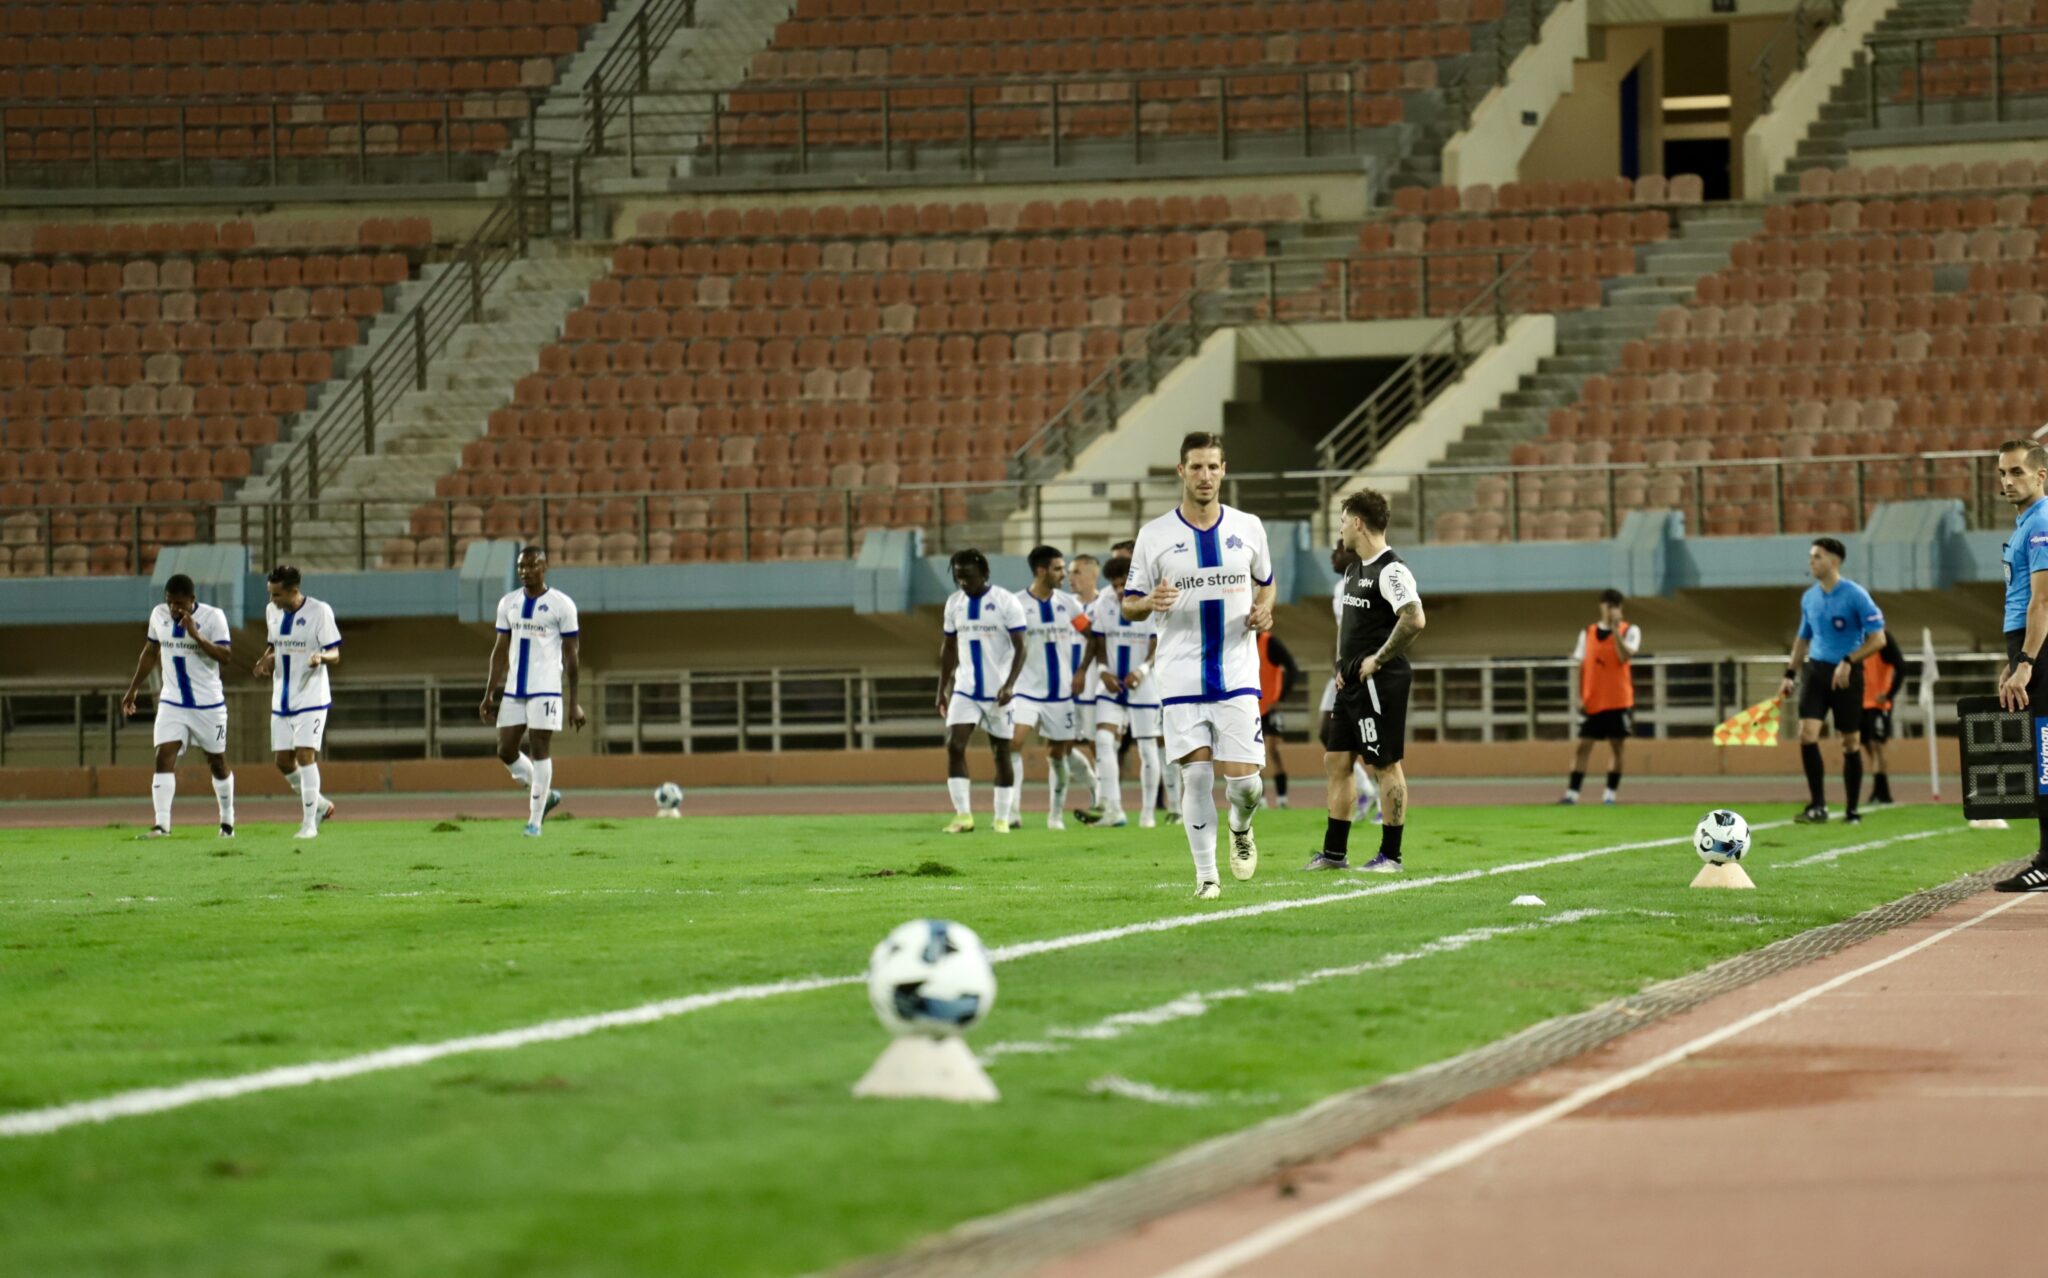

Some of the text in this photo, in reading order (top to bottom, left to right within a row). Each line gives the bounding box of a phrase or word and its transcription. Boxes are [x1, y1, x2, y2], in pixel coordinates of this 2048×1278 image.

[1175, 573, 1246, 591] elite strom
[1343, 593, 1371, 609] etsson
[543, 700, 557, 717] 14
[1358, 717, 1379, 743] 18
